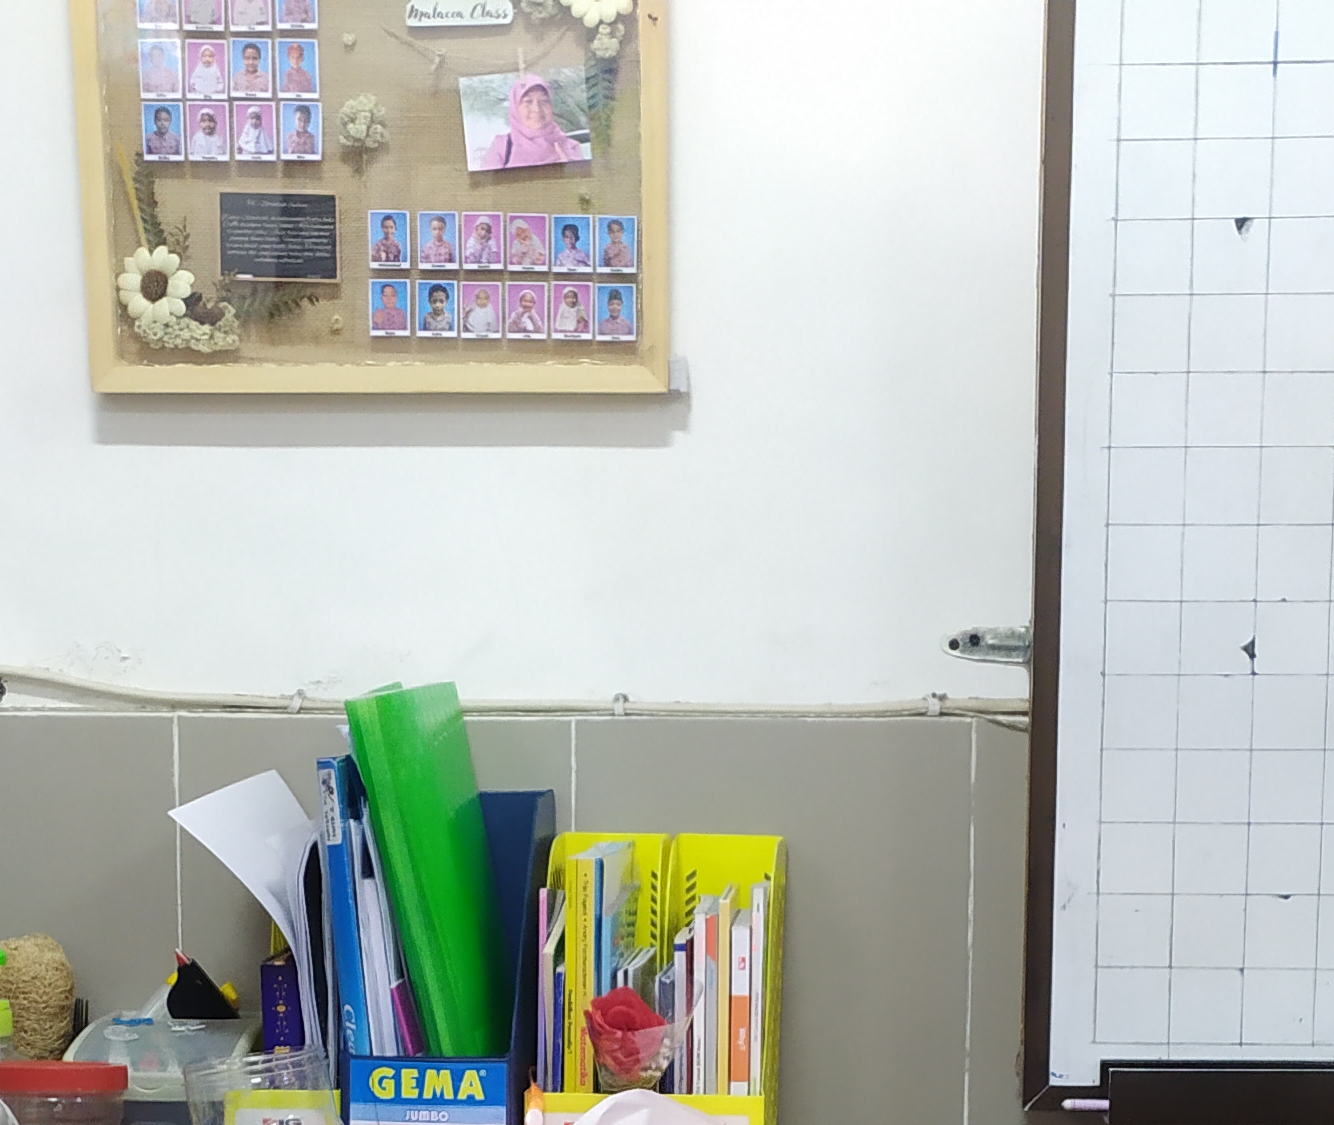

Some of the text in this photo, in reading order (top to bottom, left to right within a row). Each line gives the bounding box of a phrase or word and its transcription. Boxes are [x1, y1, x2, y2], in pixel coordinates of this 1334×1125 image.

[470, 2, 509, 19] Class
[369, 1067, 485, 1101] GEMA
[406, 1110, 449, 1122] JUMBO
